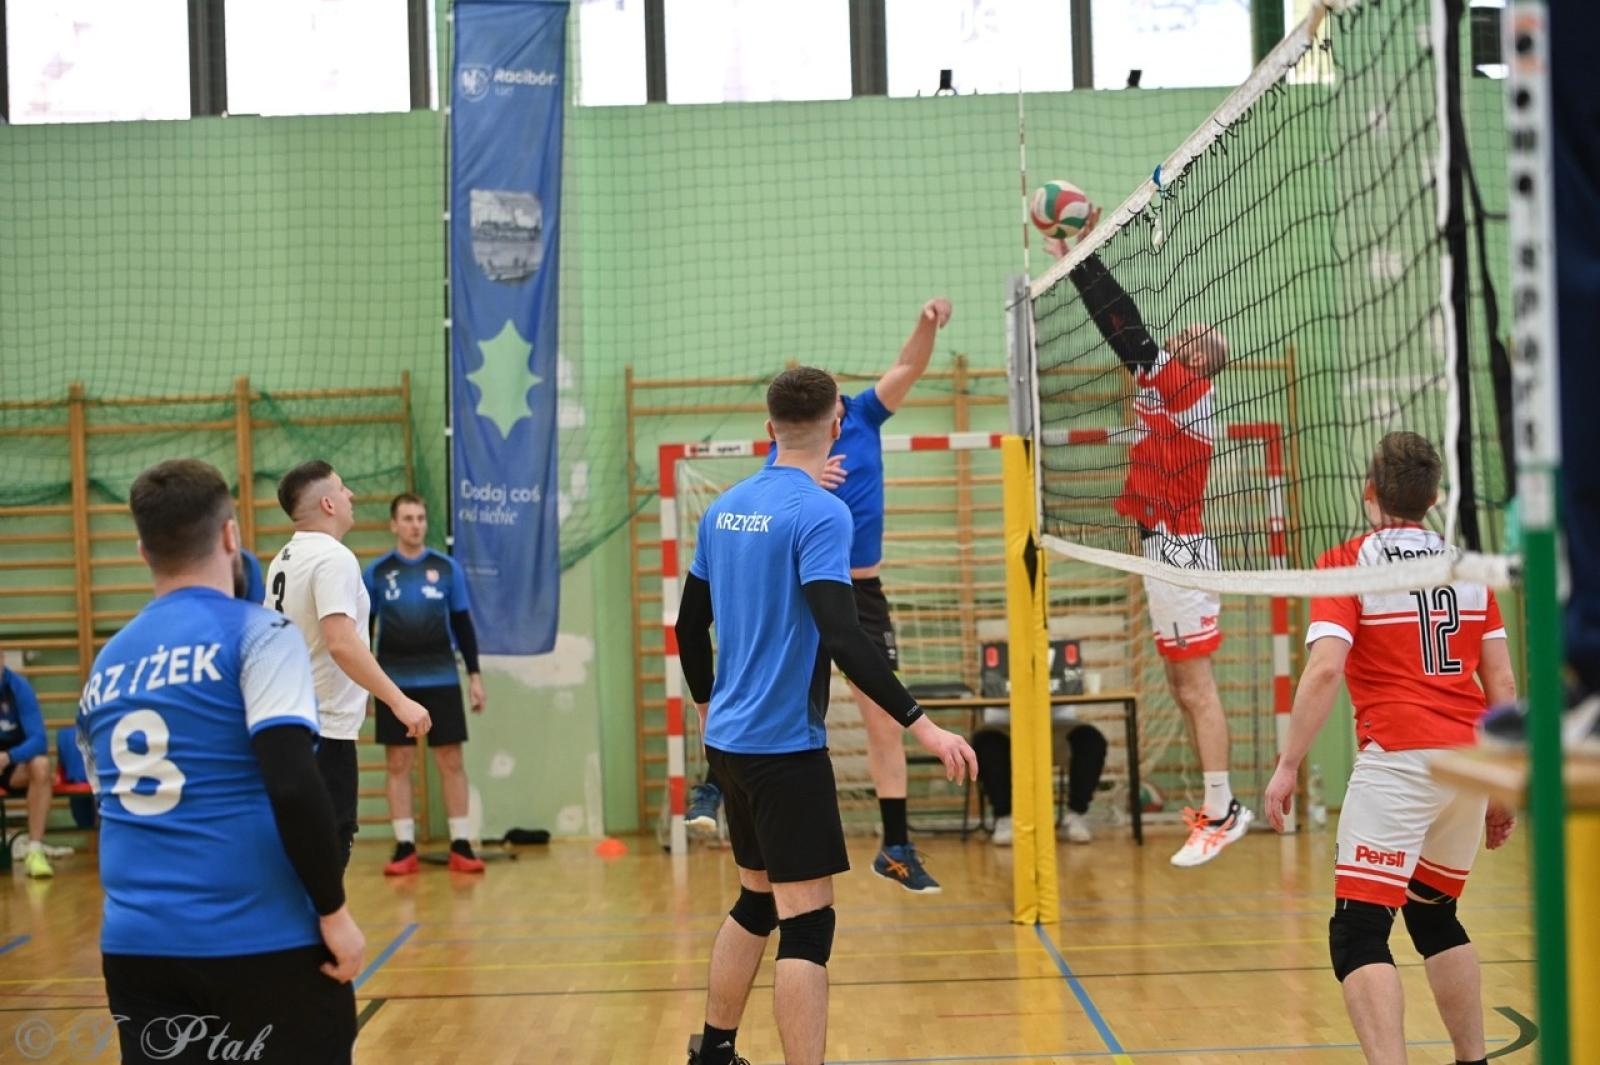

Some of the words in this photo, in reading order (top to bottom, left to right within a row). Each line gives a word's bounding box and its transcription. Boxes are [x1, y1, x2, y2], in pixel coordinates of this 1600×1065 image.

[461, 479, 507, 506] Dodaj
[716, 511, 773, 532] KRZYŻEK
[1409, 584, 1462, 676] 12
[110, 708, 187, 816] 8
[1355, 845, 1406, 868] Persil
